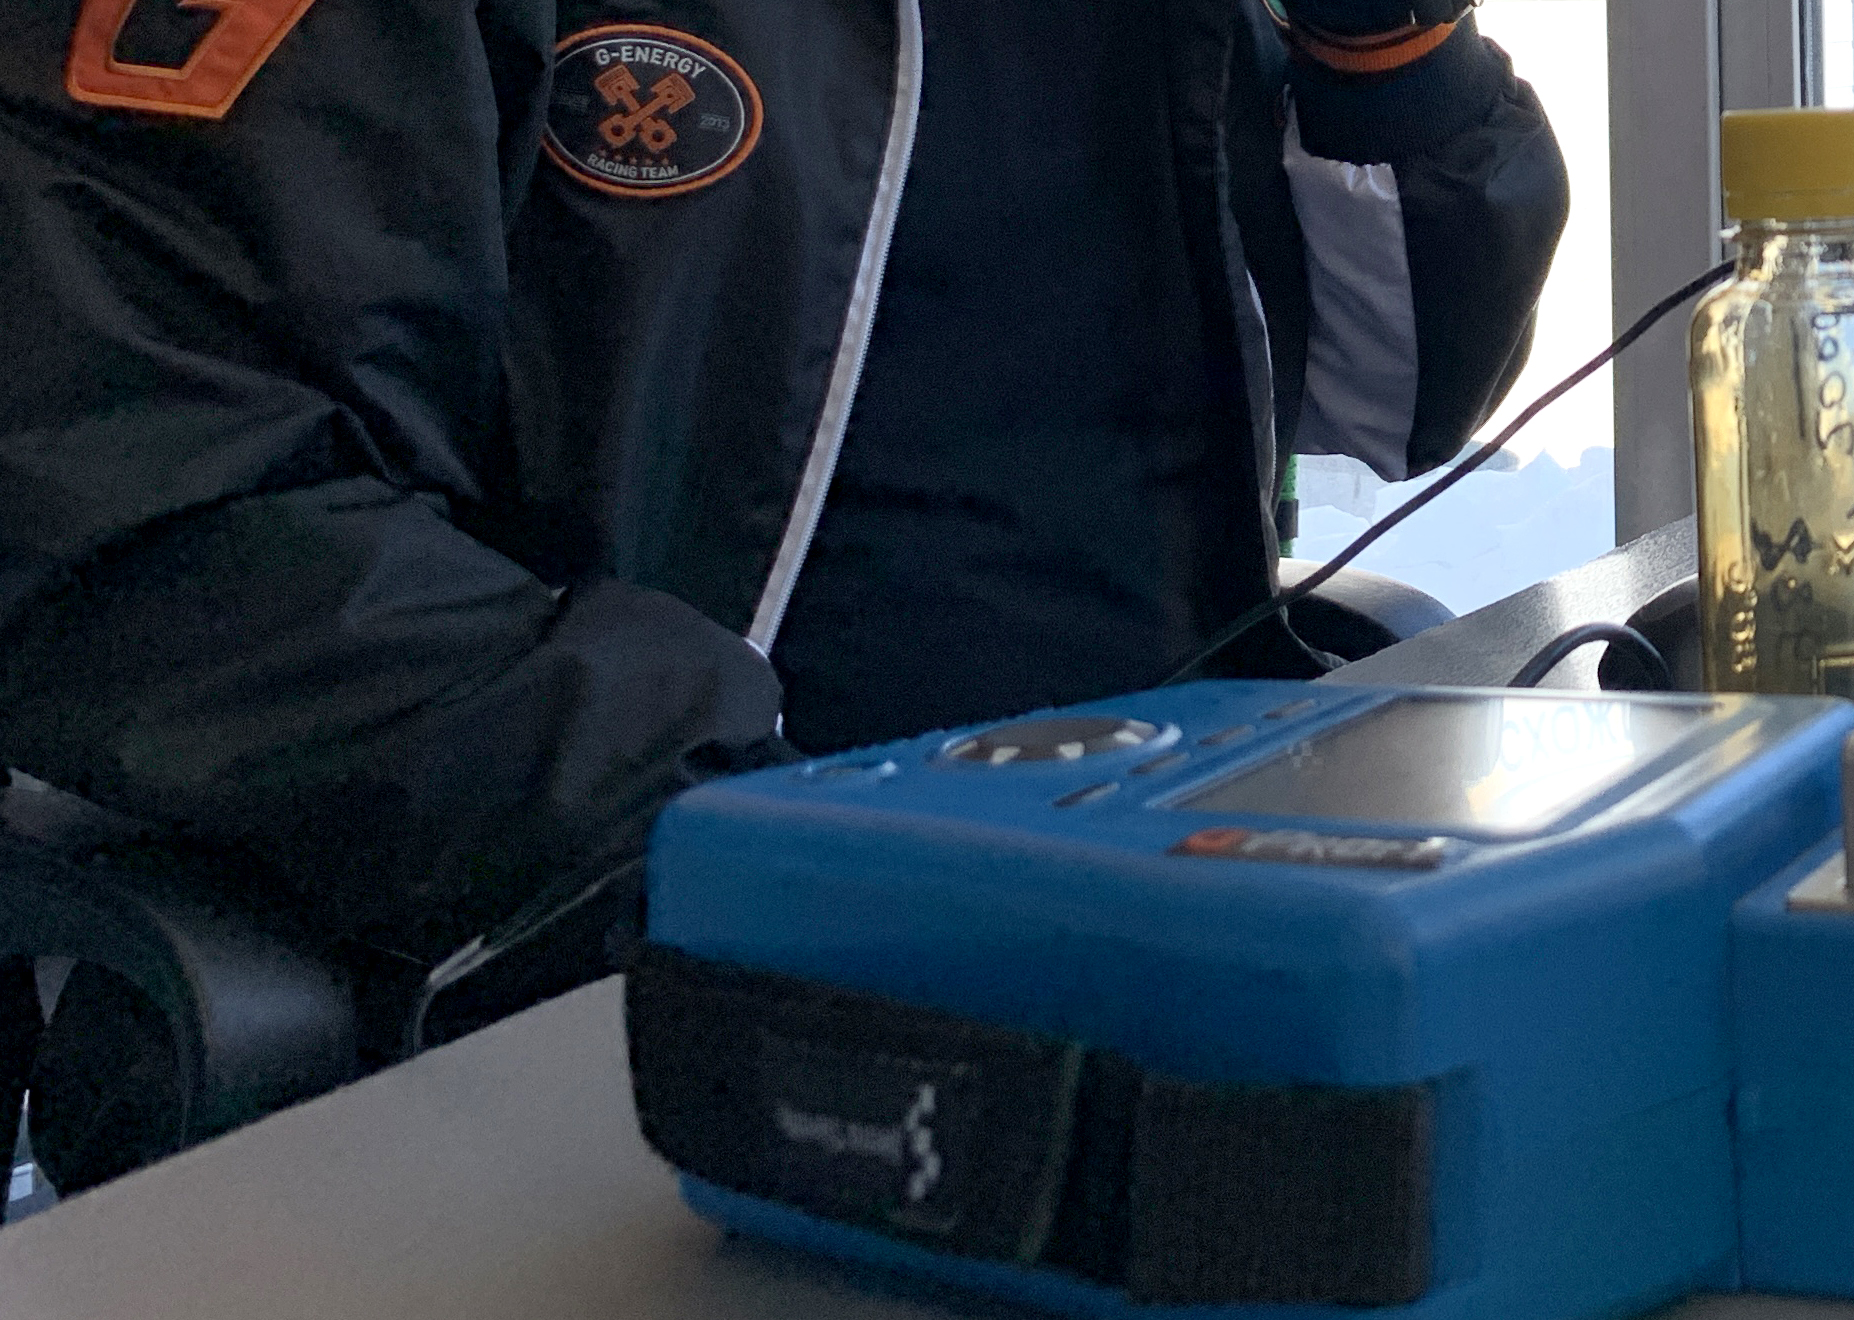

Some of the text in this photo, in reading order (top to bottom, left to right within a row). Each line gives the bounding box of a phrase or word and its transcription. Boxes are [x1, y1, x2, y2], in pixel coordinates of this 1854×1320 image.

[595, 47, 705, 78] G-ENERGY
[586, 153, 679, 179] RACING TEAM
